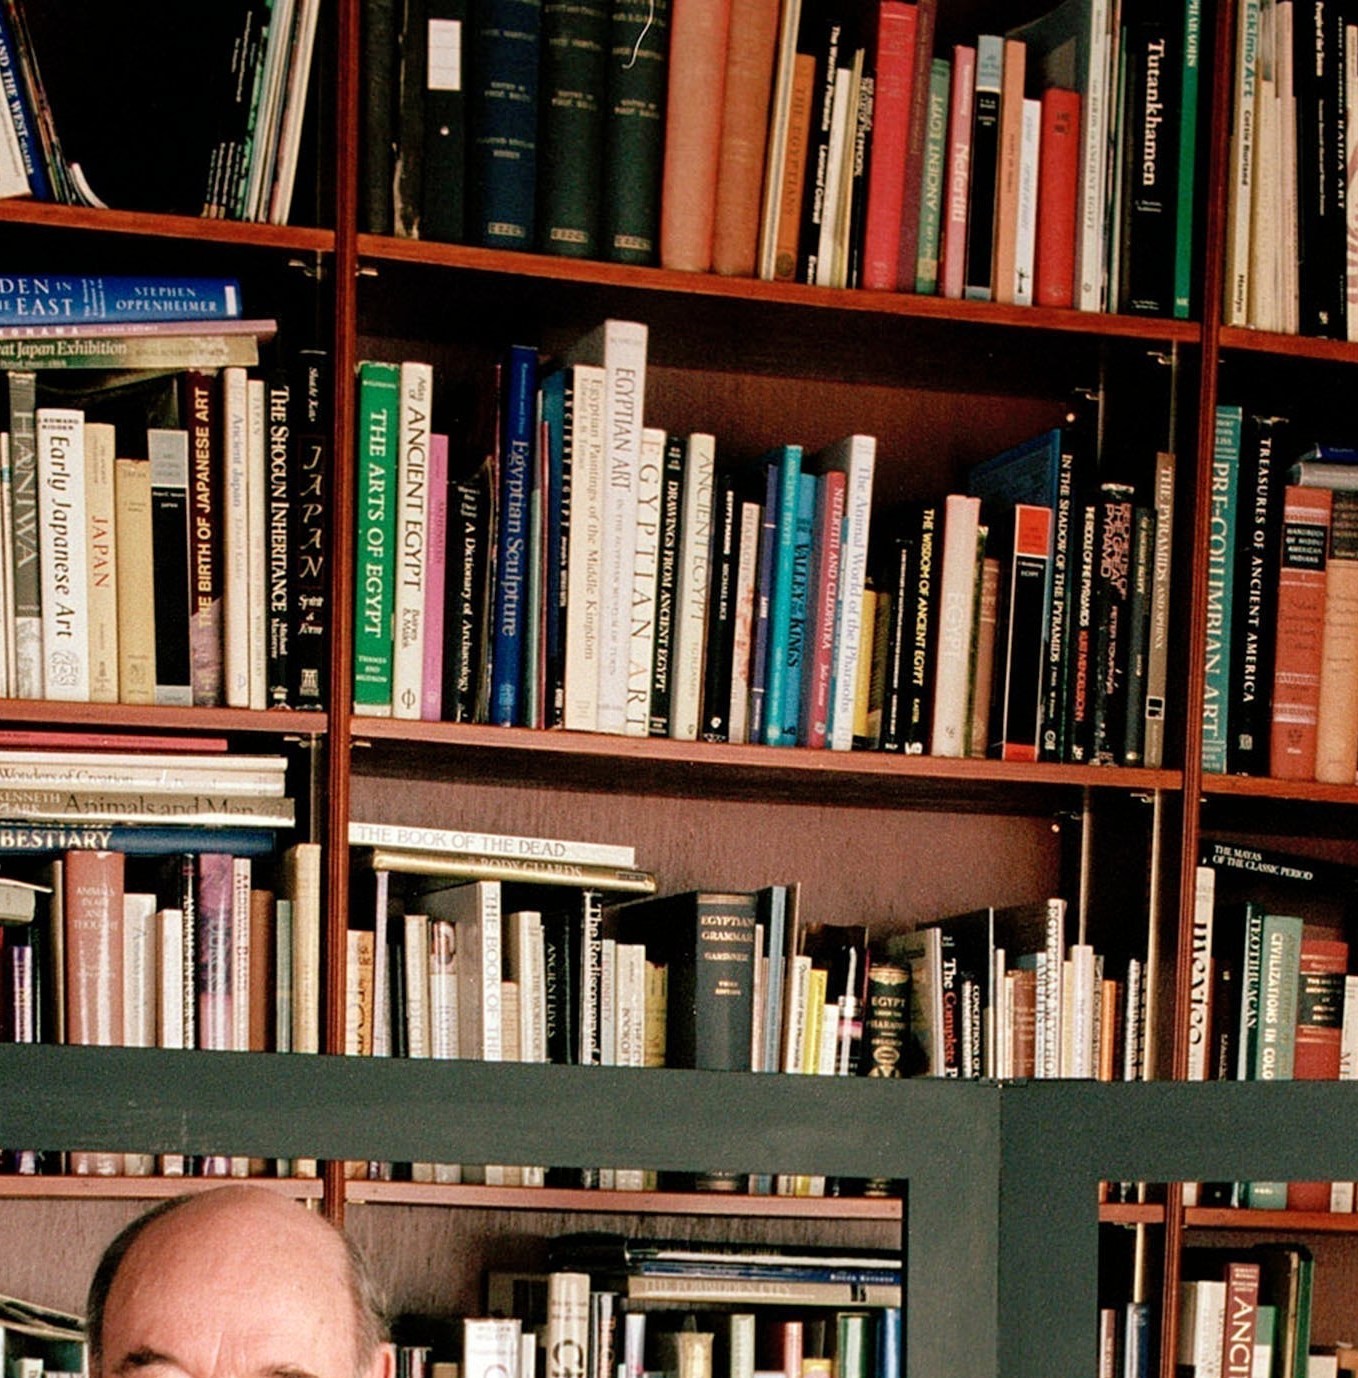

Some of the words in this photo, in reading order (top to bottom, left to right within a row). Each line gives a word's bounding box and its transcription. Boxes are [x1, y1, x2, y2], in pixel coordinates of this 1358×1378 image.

[1244, 3, 1258, 64] Eskimo
[1244, 67, 1256, 96] Art
[1142, 39, 1165, 187] Tutankhamen
[16, 298, 74, 316] EAST
[55, 281, 72, 292] IN
[116, 300, 217, 313] OPPENHEIMER
[134, 286, 196, 298] STEPHEN
[194, 387, 210, 434] ART
[269, 387, 290, 422] THE
[614, 368, 635, 451] EGYPTIAN
[269, 423, 289, 498] SHOGUN
[368, 408, 388, 459] THE
[406, 407, 427, 514] ANCIENT
[46, 435, 71, 493] Early
[196, 436, 210, 522] JAPANESE
[506, 439, 529, 536] Egyptian
[611, 457, 632, 491] ART
[1255, 437, 1272, 527] TREASURES
[367, 463, 386, 523] ARTS
[49, 498, 73, 596] Japanese
[92, 515, 109, 589] JAPAN
[197, 523, 211, 544] OF
[269, 500, 289, 614] INHERITANCE
[366, 527, 385, 558] OF
[404, 521, 423, 592] EGYPT
[1253, 529, 1266, 545] OF
[197, 545, 212, 593] BIRTH
[501, 536, 524, 637] Sculpture
[1206, 459, 1231, 674] PRE-COLUMBIAN
[1248, 547, 1264, 622] ANCIENT
[54, 601, 73, 638] Art
[197, 595, 213, 630] THE
[364, 566, 384, 639] EGYPT
[1243, 629, 1261, 703] AMERICA
[1202, 682, 1223, 739] ART
[0, 831, 113, 849] BESTIARY
[357, 825, 392, 842] THE
[396, 828, 445, 847] BOOK
[451, 833, 475, 849] OF
[482, 836, 515, 854] THE
[518, 841, 566, 858] DEAD
[701, 916, 755, 927] EGYPTIAN
[701, 930, 753, 942] GRAMMAR
[544, 943, 557, 997] ANCIENT
[1247, 914, 1262, 1029] TEOTIHUACAN
[545, 1000, 556, 1039] LIVES
